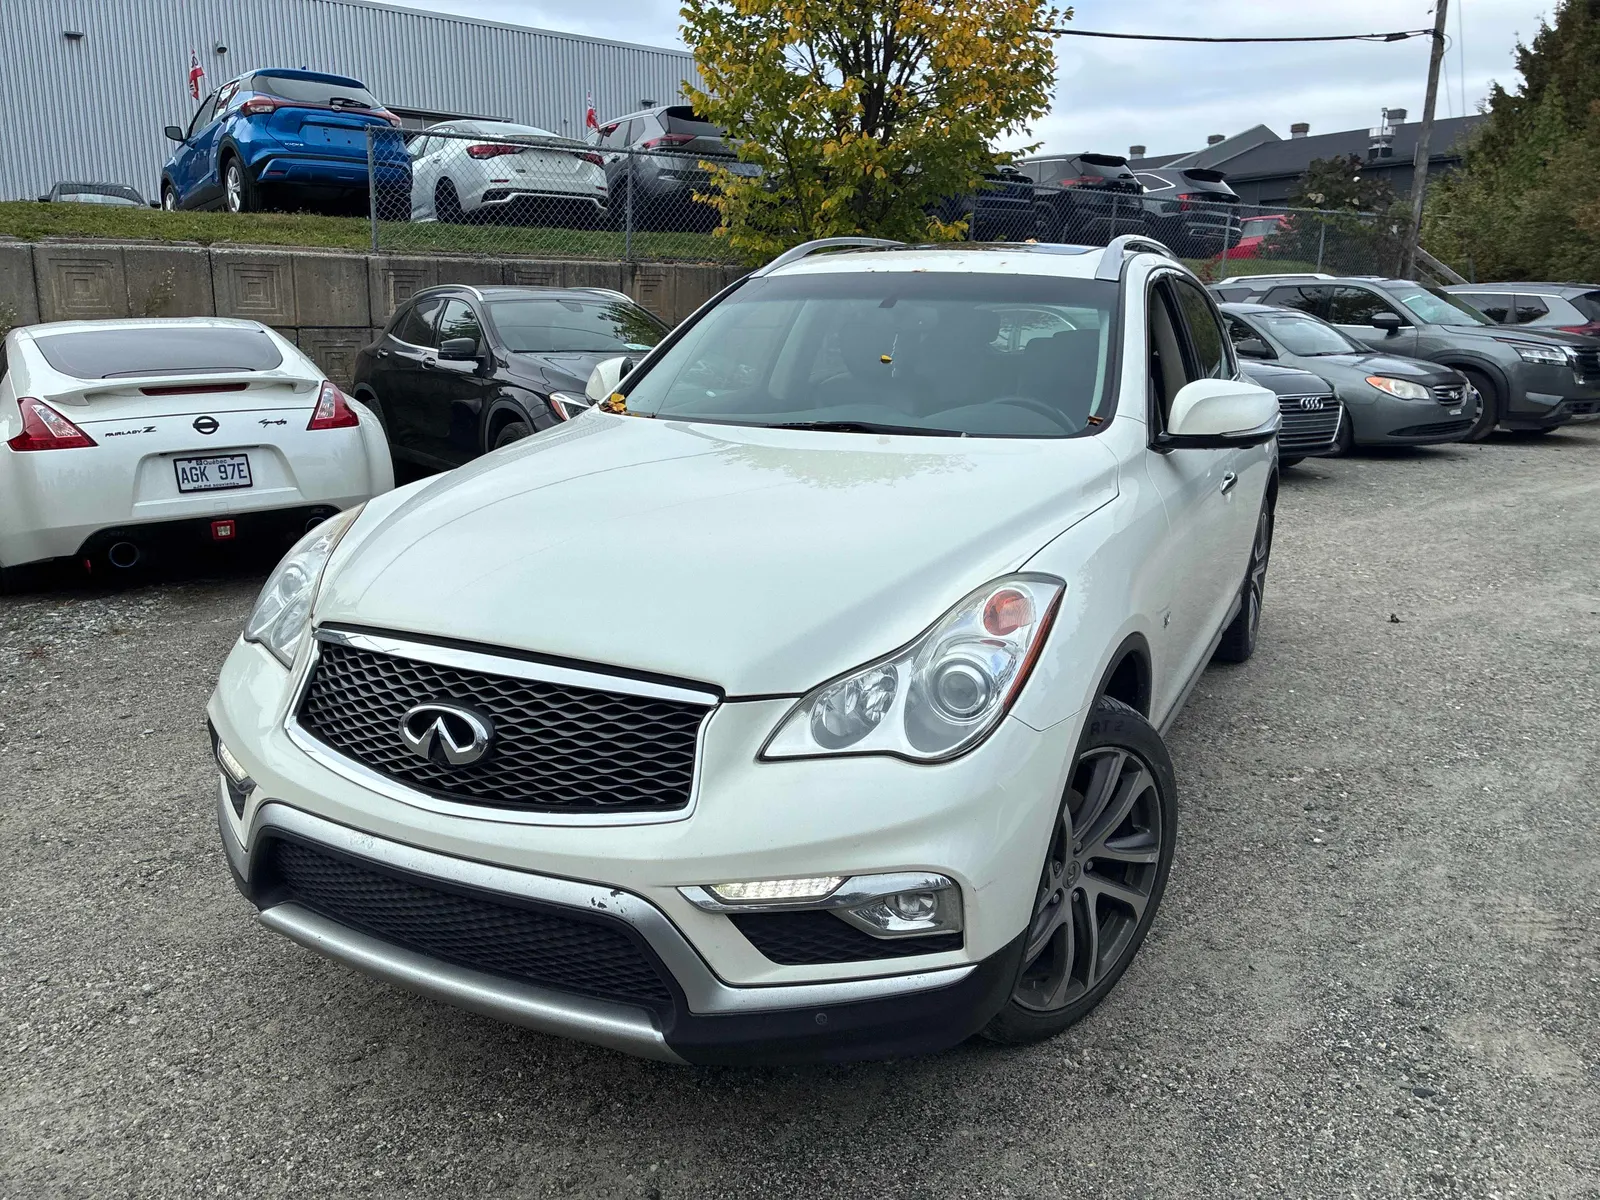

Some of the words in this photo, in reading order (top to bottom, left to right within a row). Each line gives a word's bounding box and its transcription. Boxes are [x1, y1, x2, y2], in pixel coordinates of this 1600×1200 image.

[142, 425, 157, 433] Z
[181, 466, 210, 484] AGK
[218, 462, 248, 480] 97E
